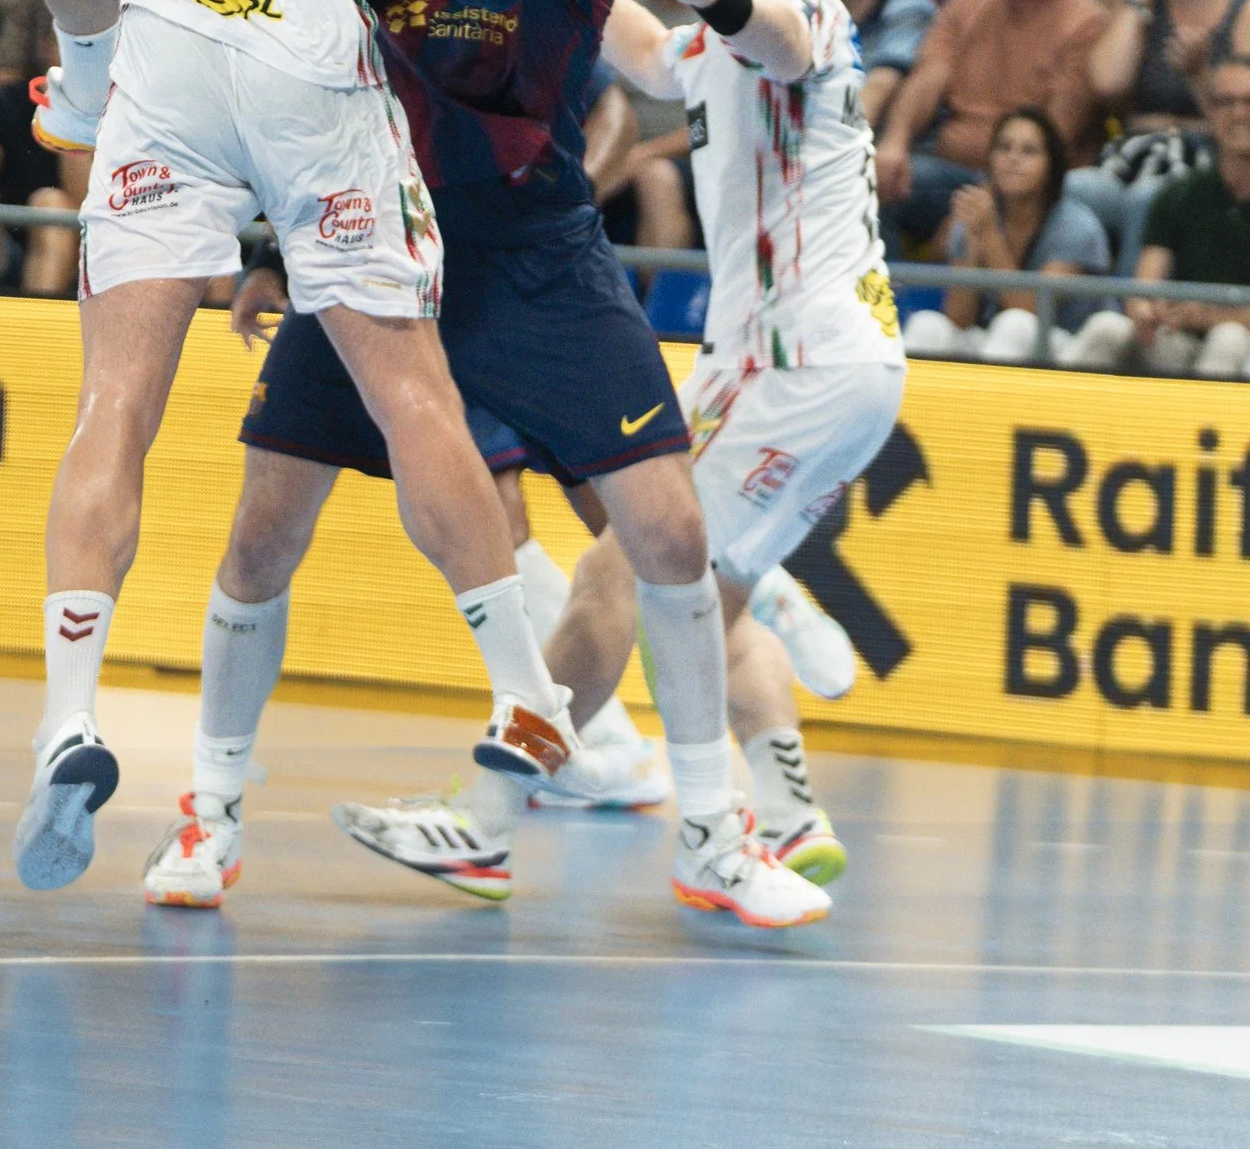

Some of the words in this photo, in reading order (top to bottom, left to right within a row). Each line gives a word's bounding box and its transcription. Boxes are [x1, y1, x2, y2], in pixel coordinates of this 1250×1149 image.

[111, 159, 158, 188] Town
[159, 166, 171, 180] &
[132, 192, 163, 206] HAUS
[317, 189, 365, 213] Town
